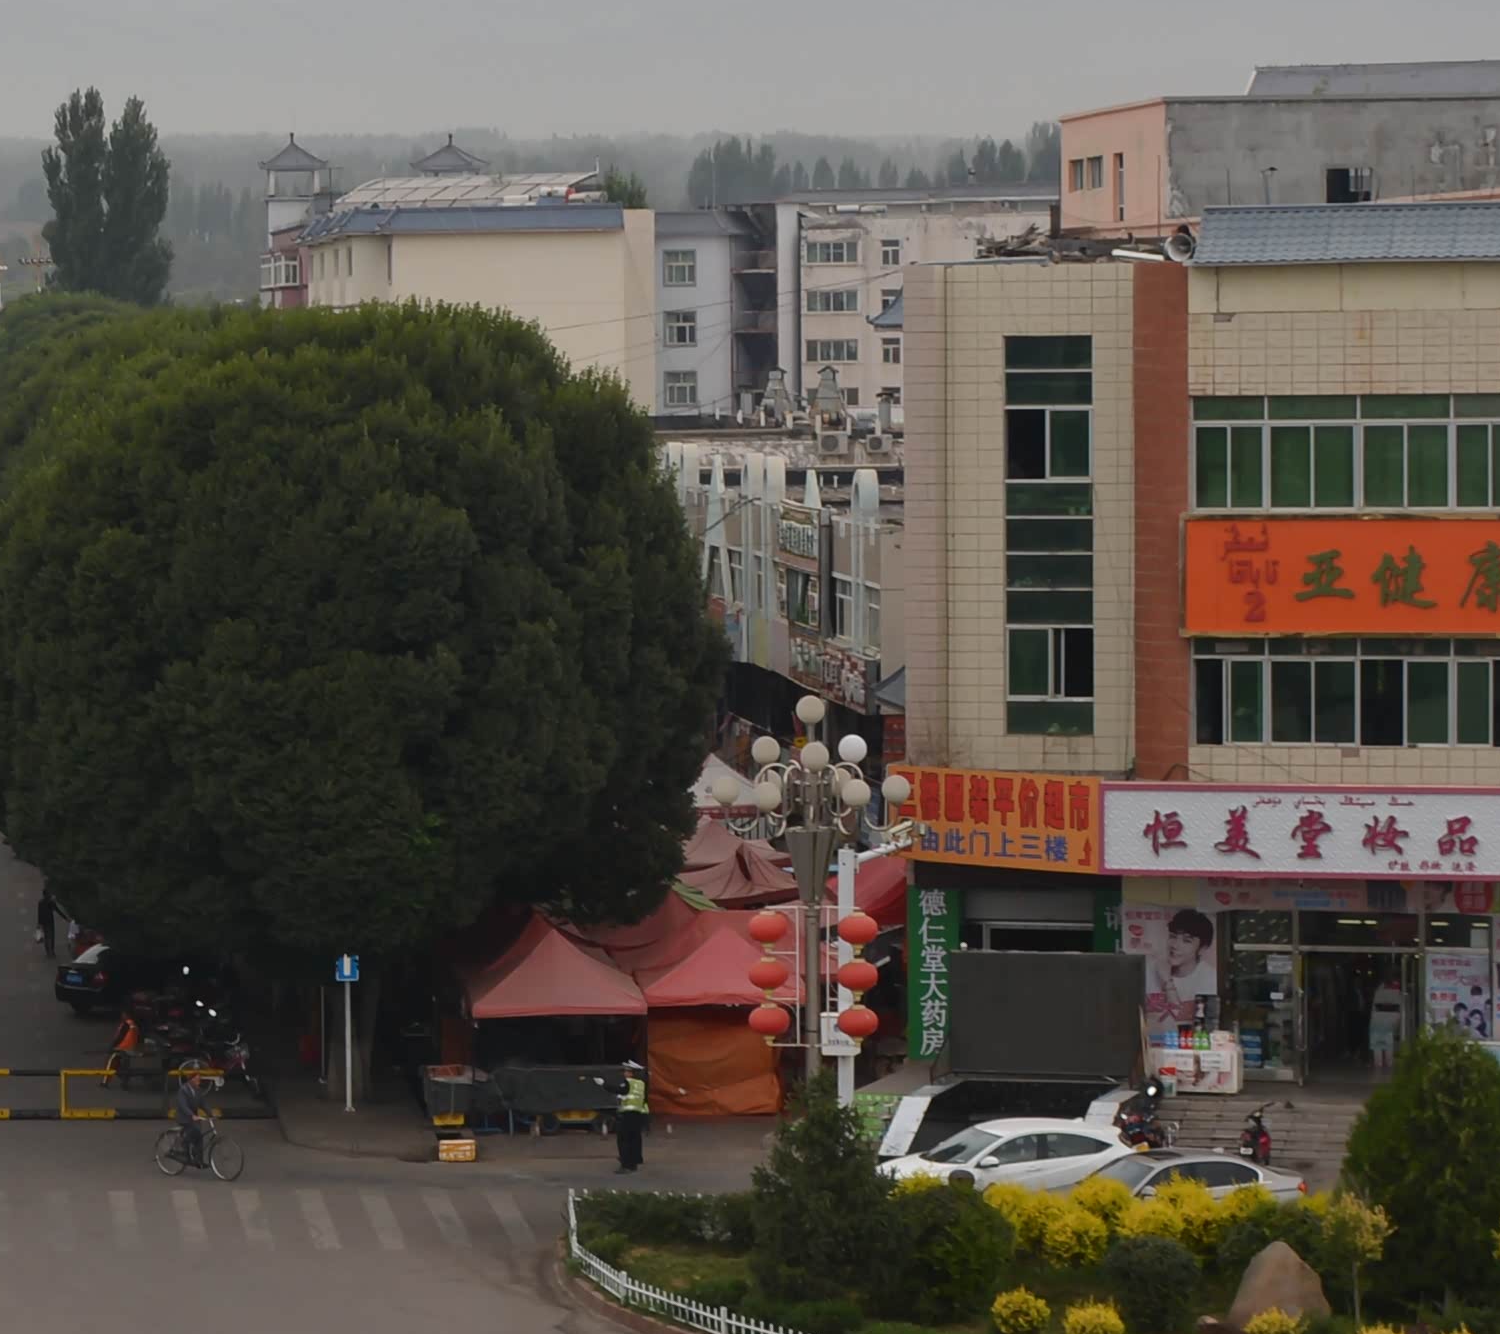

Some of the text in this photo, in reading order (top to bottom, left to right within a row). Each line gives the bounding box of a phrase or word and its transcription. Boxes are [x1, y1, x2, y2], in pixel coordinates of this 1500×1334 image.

[920, 828, 1069, 863] 由此门上三楼
[1142, 805, 1479, 861] 恒美堂妆品
[918, 888, 949, 1056] 德仁堂大药房
